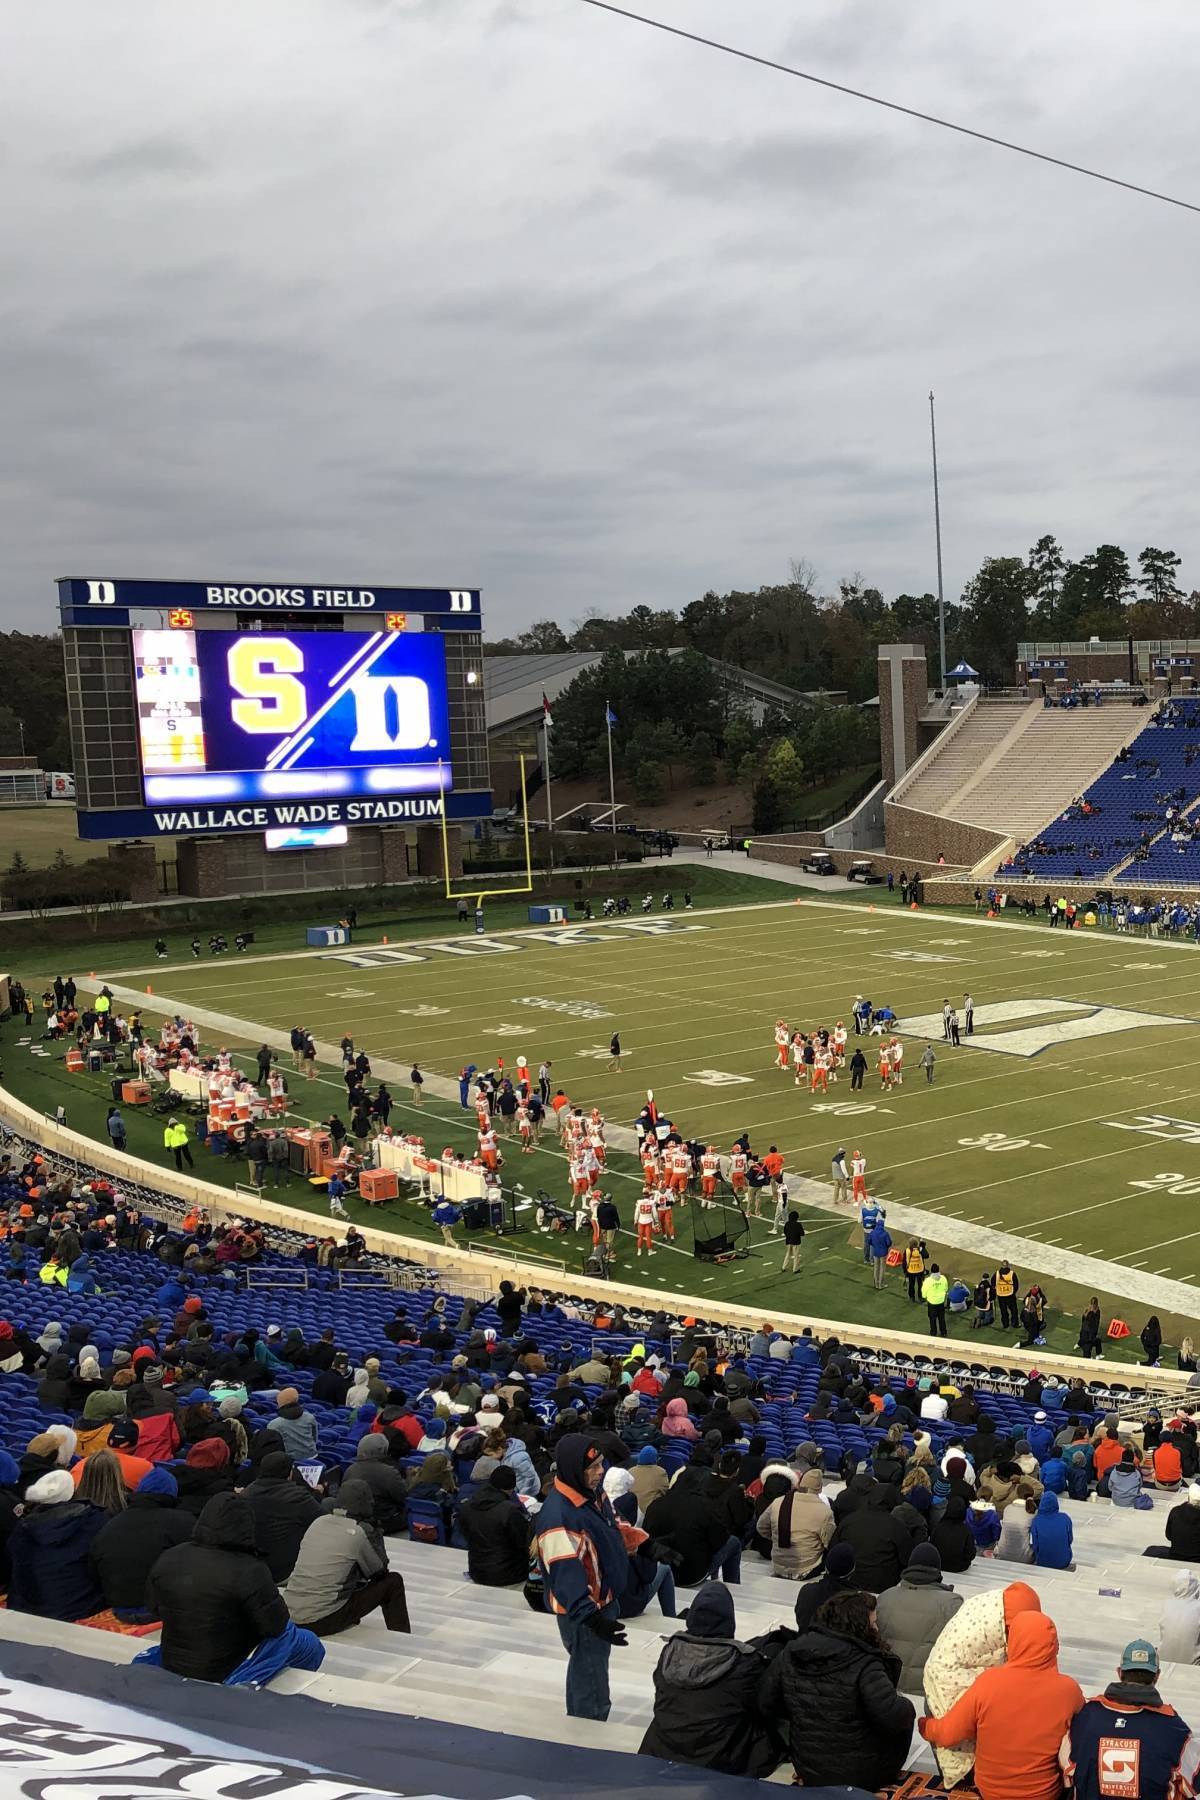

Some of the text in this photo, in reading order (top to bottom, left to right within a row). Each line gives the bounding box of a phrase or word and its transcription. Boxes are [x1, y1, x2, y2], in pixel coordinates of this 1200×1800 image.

[86, 581, 116, 604] D
[206, 587, 376, 608] BROOKS FIELD
[449, 591, 472, 612] D
[171, 612, 192, 627] 25
[388, 616, 405, 629] 25
[227, 637, 308, 734] S
[349, 673, 431, 751] D
[167, 719, 177, 731] S
[153, 799, 445, 831] WALLACE WADE STADIUM
[317, 919, 718, 968] DUKE
[808, 1101, 877, 1116] 40
[957, 1132, 1031, 1151] 30
[889, 1251, 899, 1263] 20
[1110, 1321, 1121, 1336] 10
[1101, 1739, 1138, 1749] SYRACUSE
[1102, 1749, 1136, 1783] S
